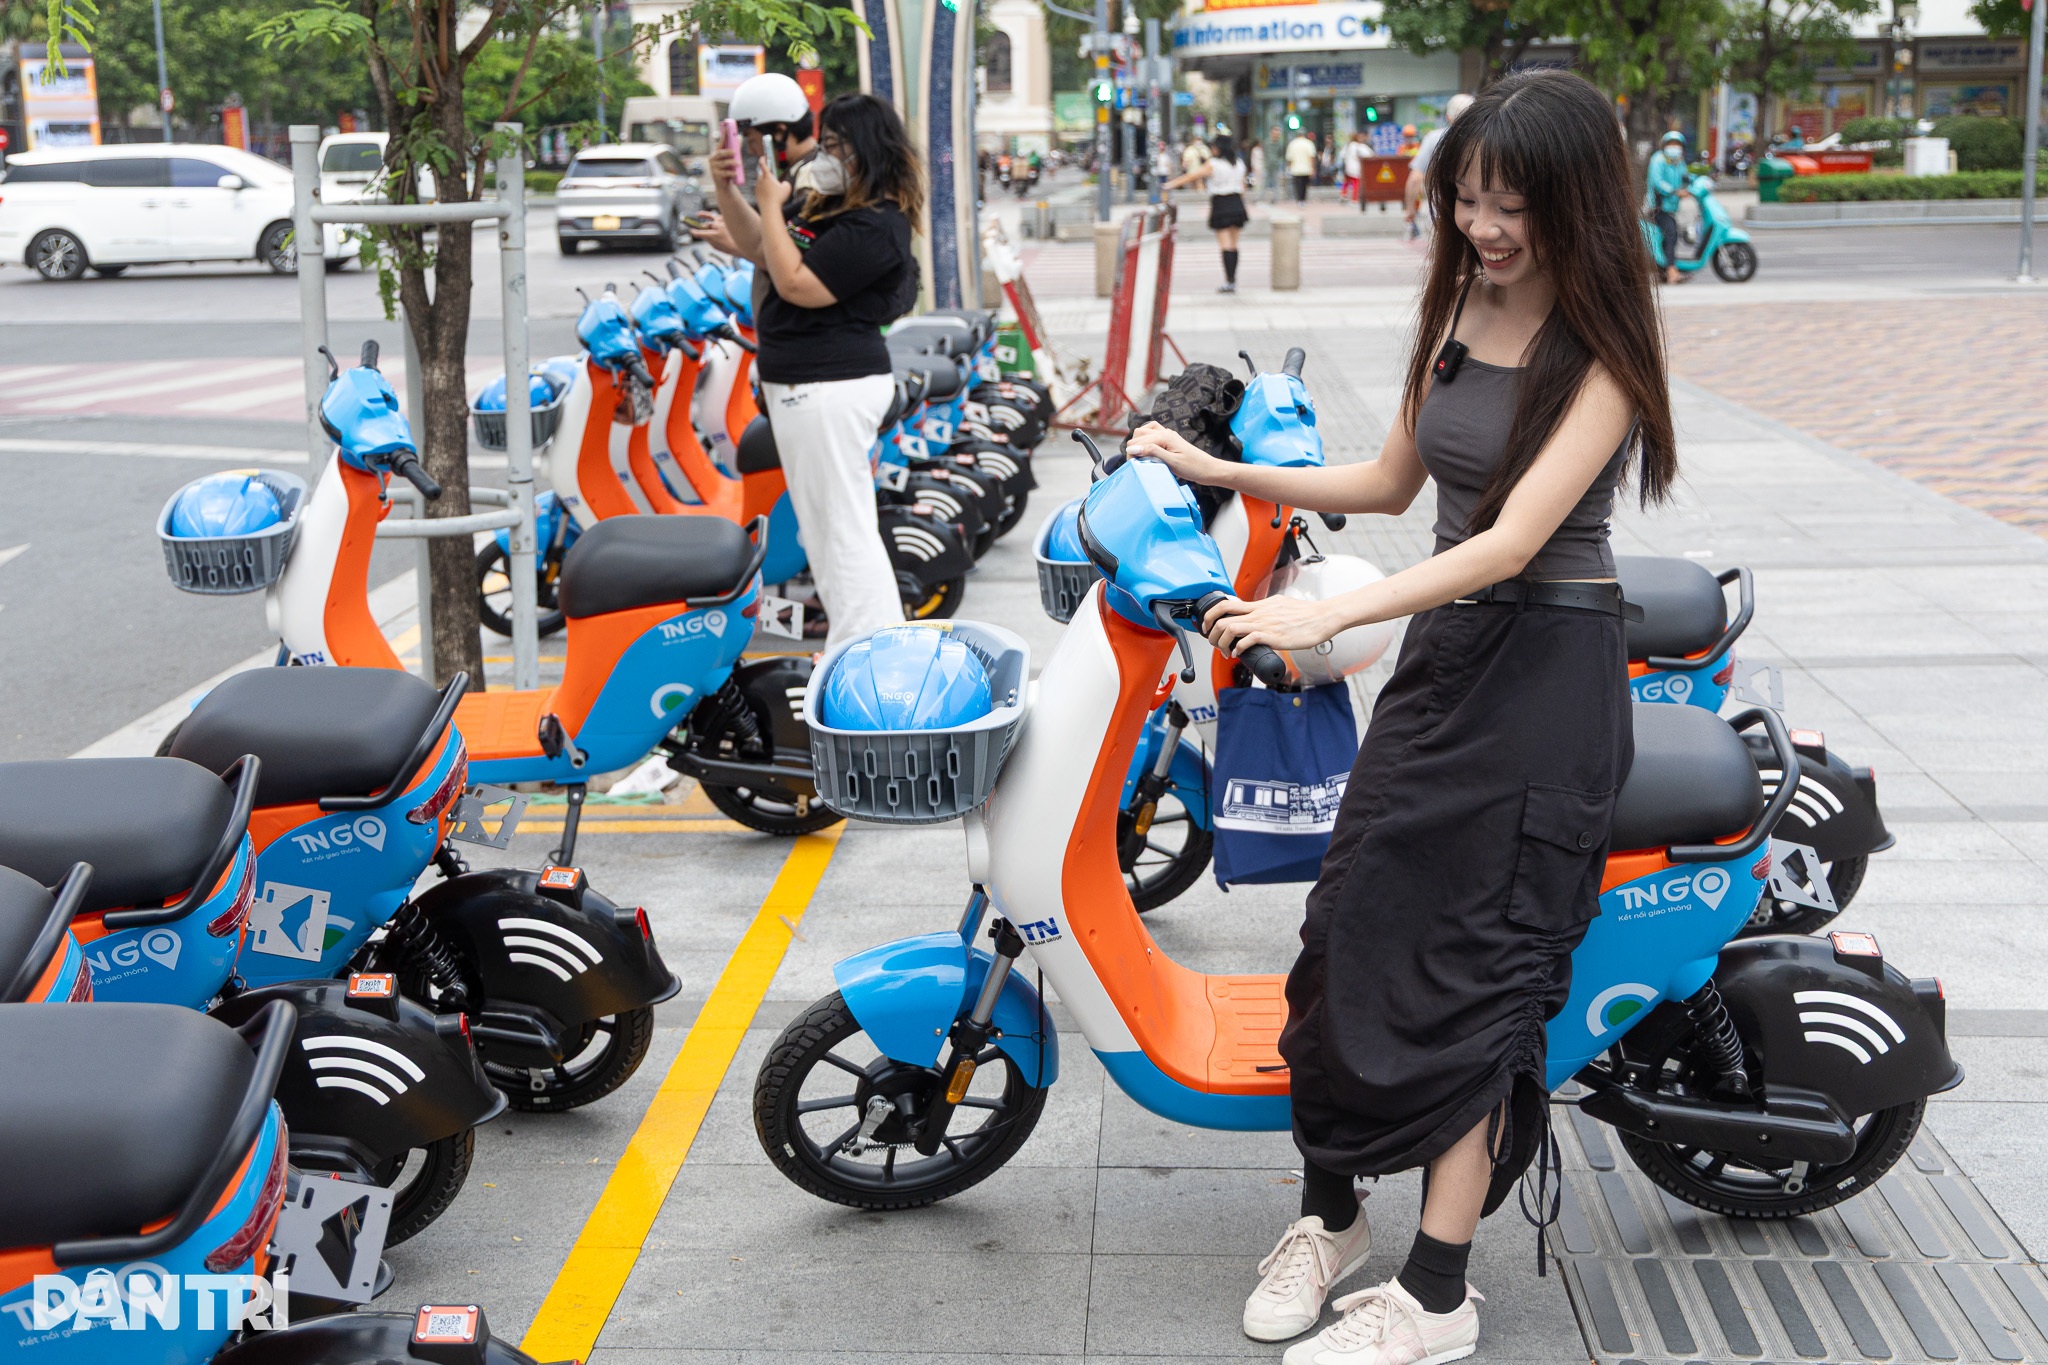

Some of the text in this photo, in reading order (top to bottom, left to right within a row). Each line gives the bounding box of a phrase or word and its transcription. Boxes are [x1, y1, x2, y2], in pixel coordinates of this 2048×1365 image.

[658, 609, 728, 639] TNGO
[301, 651, 324, 665] TN
[1631, 674, 1694, 704] NGO
[1188, 704, 1216, 721] TN
[291, 815, 387, 854] TNGO
[1616, 867, 1731, 911] TNGO
[1648, 909, 1666, 918] giao
[1667, 903, 1692, 914] thông
[1018, 917, 1060, 941] TN
[86, 928, 182, 977] NGO
[104, 974, 122, 984] giao
